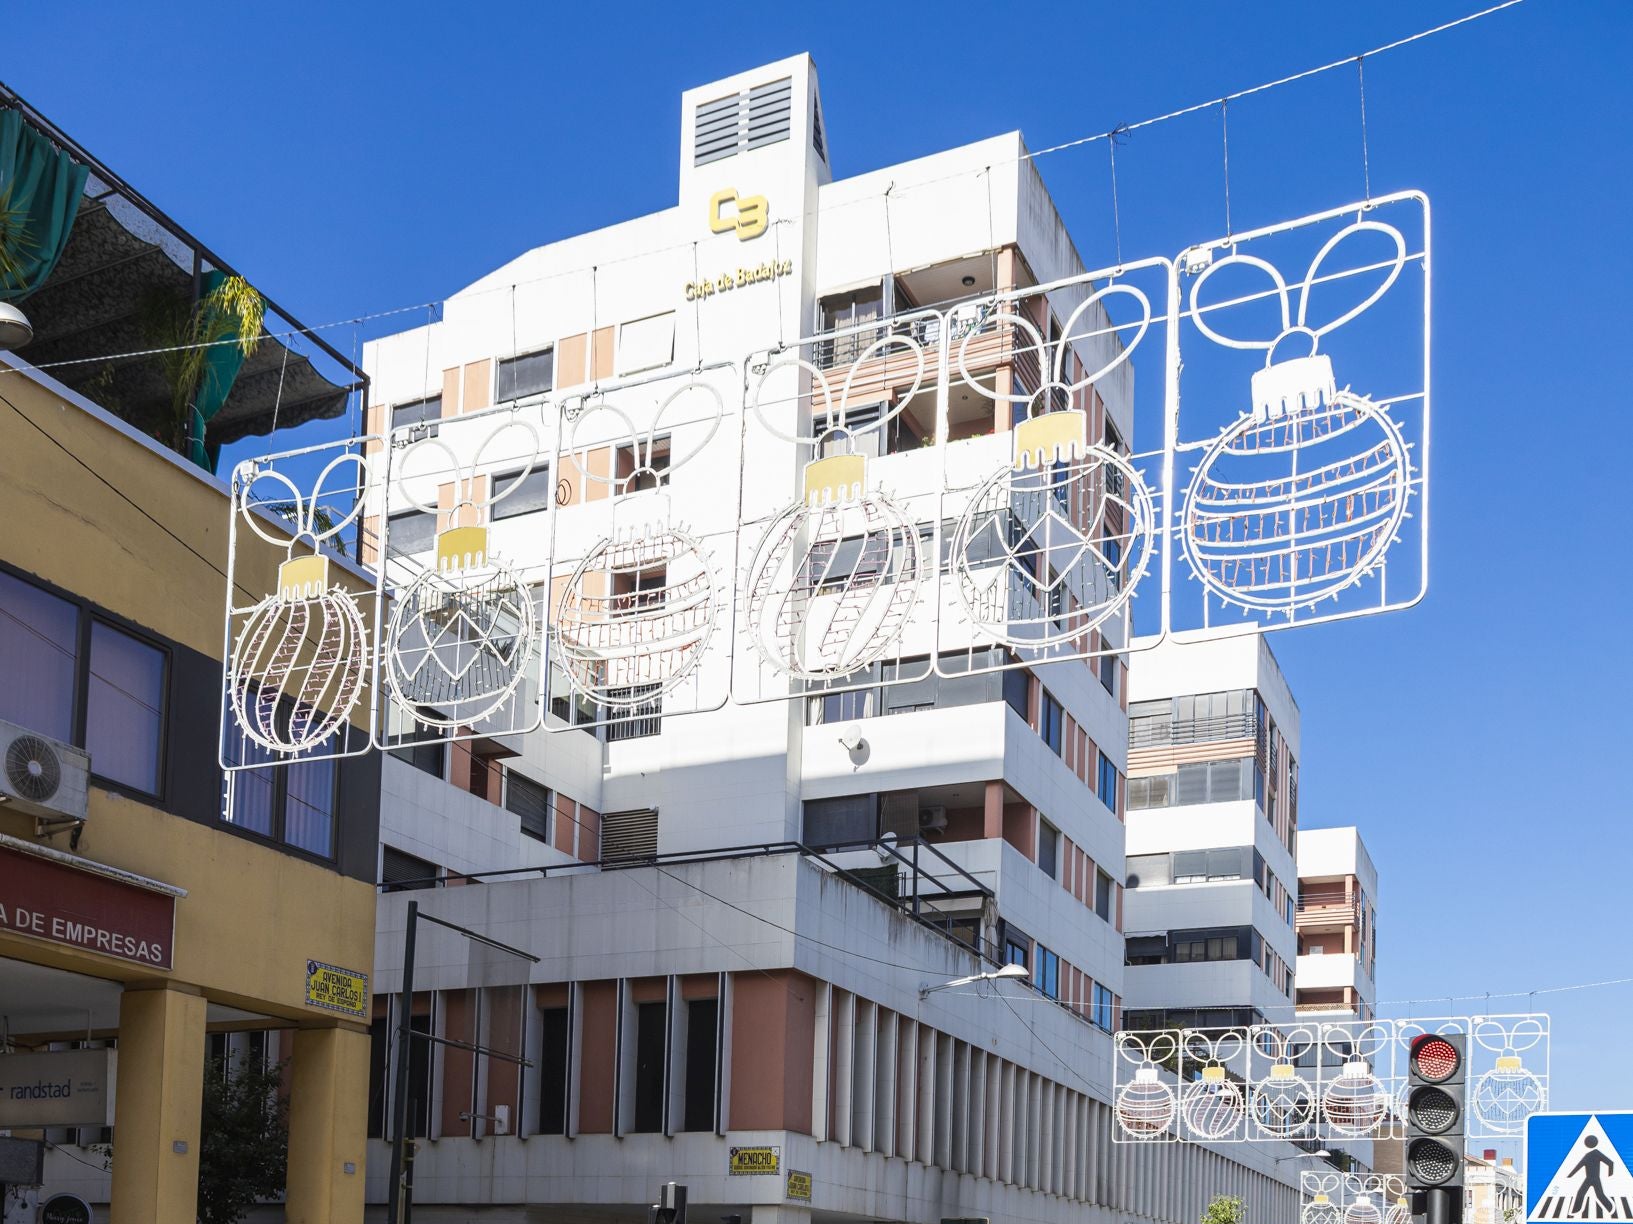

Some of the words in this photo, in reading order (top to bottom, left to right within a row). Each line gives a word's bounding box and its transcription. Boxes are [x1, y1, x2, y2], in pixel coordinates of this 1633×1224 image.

[684, 278, 716, 302] Caja
[717, 273, 734, 293] de
[735, 259, 793, 286] Badajoz
[15, 907, 46, 933] DE
[52, 916, 163, 963] EMPRESAS
[311, 980, 330, 995] JUAN
[332, 985, 358, 1002] CARLOS
[323, 972, 352, 988] AVENIDA
[10, 1078, 72, 1100] randstad
[738, 1152, 772, 1165] MENACHO
